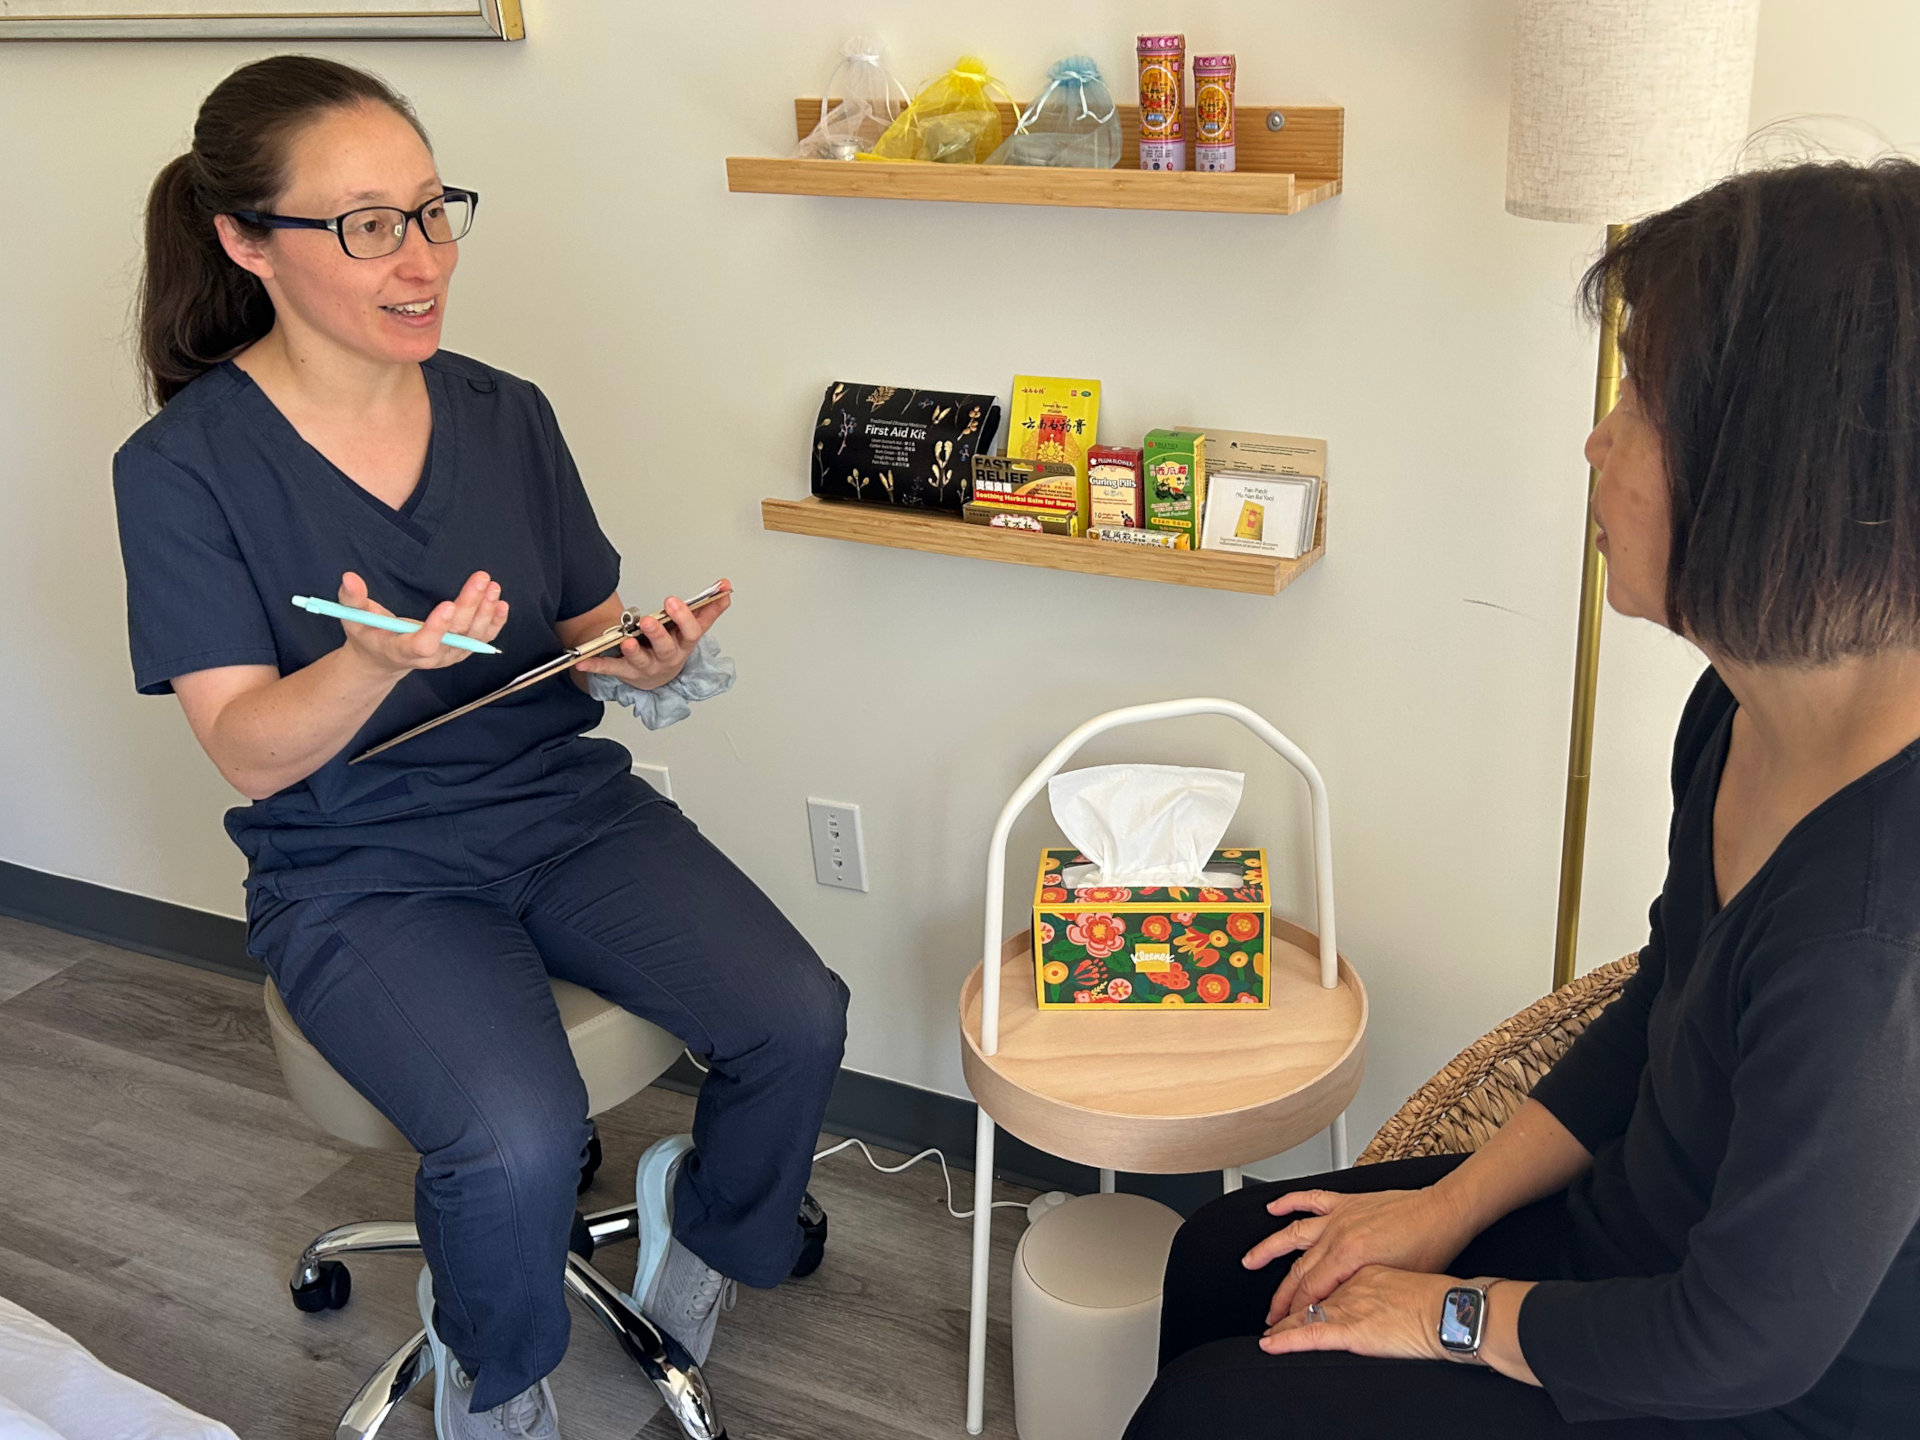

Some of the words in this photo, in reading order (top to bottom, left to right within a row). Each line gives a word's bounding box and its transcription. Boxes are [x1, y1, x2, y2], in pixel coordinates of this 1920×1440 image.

[865, 424, 889, 436] First
[890, 426, 909, 439] Aid
[910, 428, 927, 440] Kit
[1021, 416, 1086, 435] 云南白药膏
[975, 457, 1011, 470] FAST
[1045, 465, 1074, 473] SOLSTICE
[1157, 465, 1188, 475] 西瓜霜
[976, 469, 1028, 484] RELIEF
[1089, 476, 1118, 489] Curing
[1119, 478, 1137, 488] Pills
[976, 491, 1004, 501] Soothing
[1005, 494, 1026, 502] Herbal
[1027, 496, 1044, 505] Balm
[1056, 500, 1076, 508] Burns
[1130, 950, 1175, 965] Kleenex
